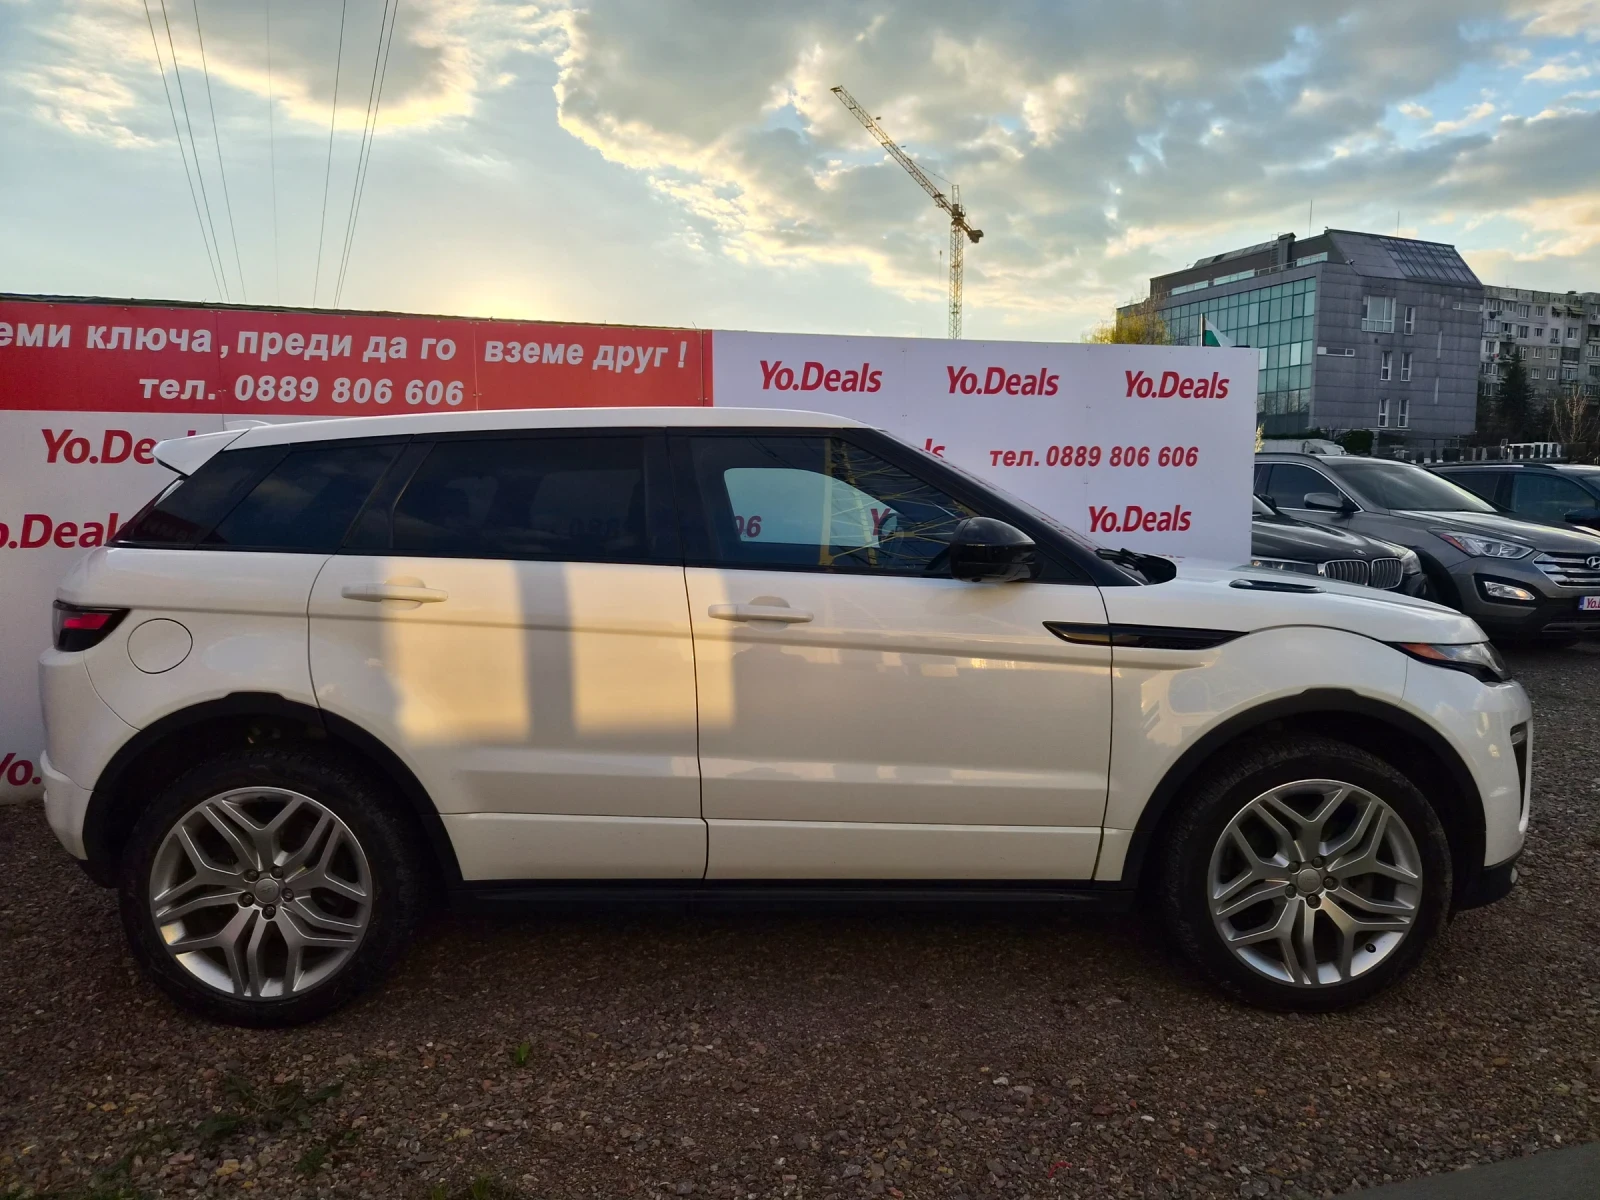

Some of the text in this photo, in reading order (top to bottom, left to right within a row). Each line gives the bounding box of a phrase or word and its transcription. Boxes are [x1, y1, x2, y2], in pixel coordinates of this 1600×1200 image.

[362, 336, 408, 363] да
[420, 338, 457, 361] го
[484, 340, 584, 365] вземе
[139, 375, 464, 405] тел. 0889 806 606
[760, 361, 882, 393] Yo.Deals
[946, 366, 1060, 396] Yo.Deals
[1124, 371, 1230, 399] Yo.Deals
[989, 445, 1199, 467] тел. 0889 806 606
[1088, 504, 1192, 532] Yo.Deals
